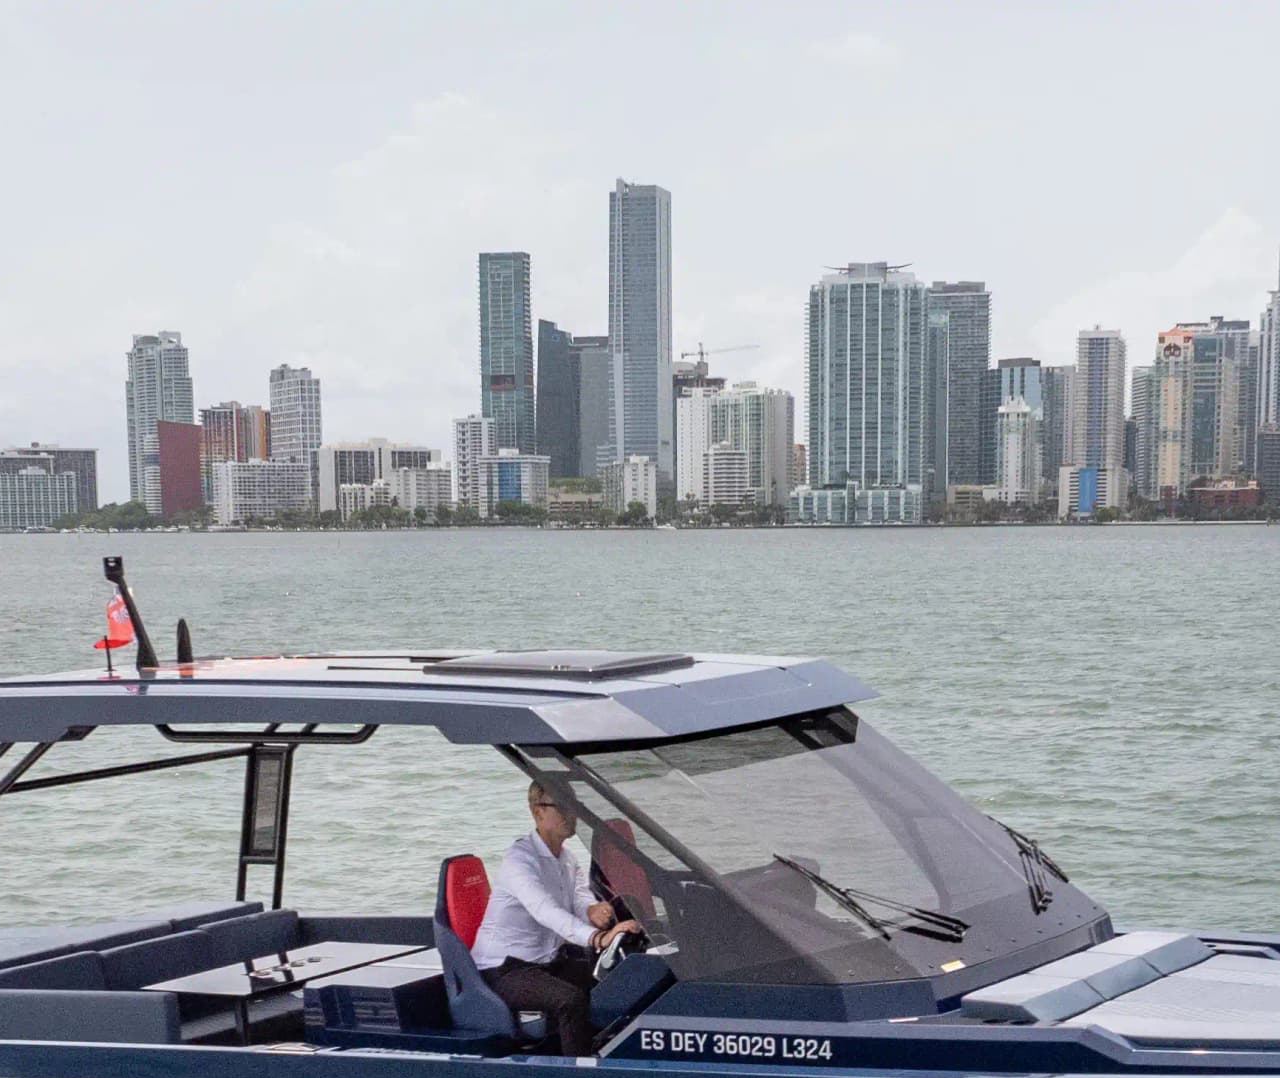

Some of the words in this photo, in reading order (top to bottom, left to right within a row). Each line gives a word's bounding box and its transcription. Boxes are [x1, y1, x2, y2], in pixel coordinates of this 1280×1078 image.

[641, 1030, 665, 1050] ES
[671, 1032, 708, 1054] DEY
[713, 1034, 776, 1057] 36029
[782, 1037, 833, 1060] L324
